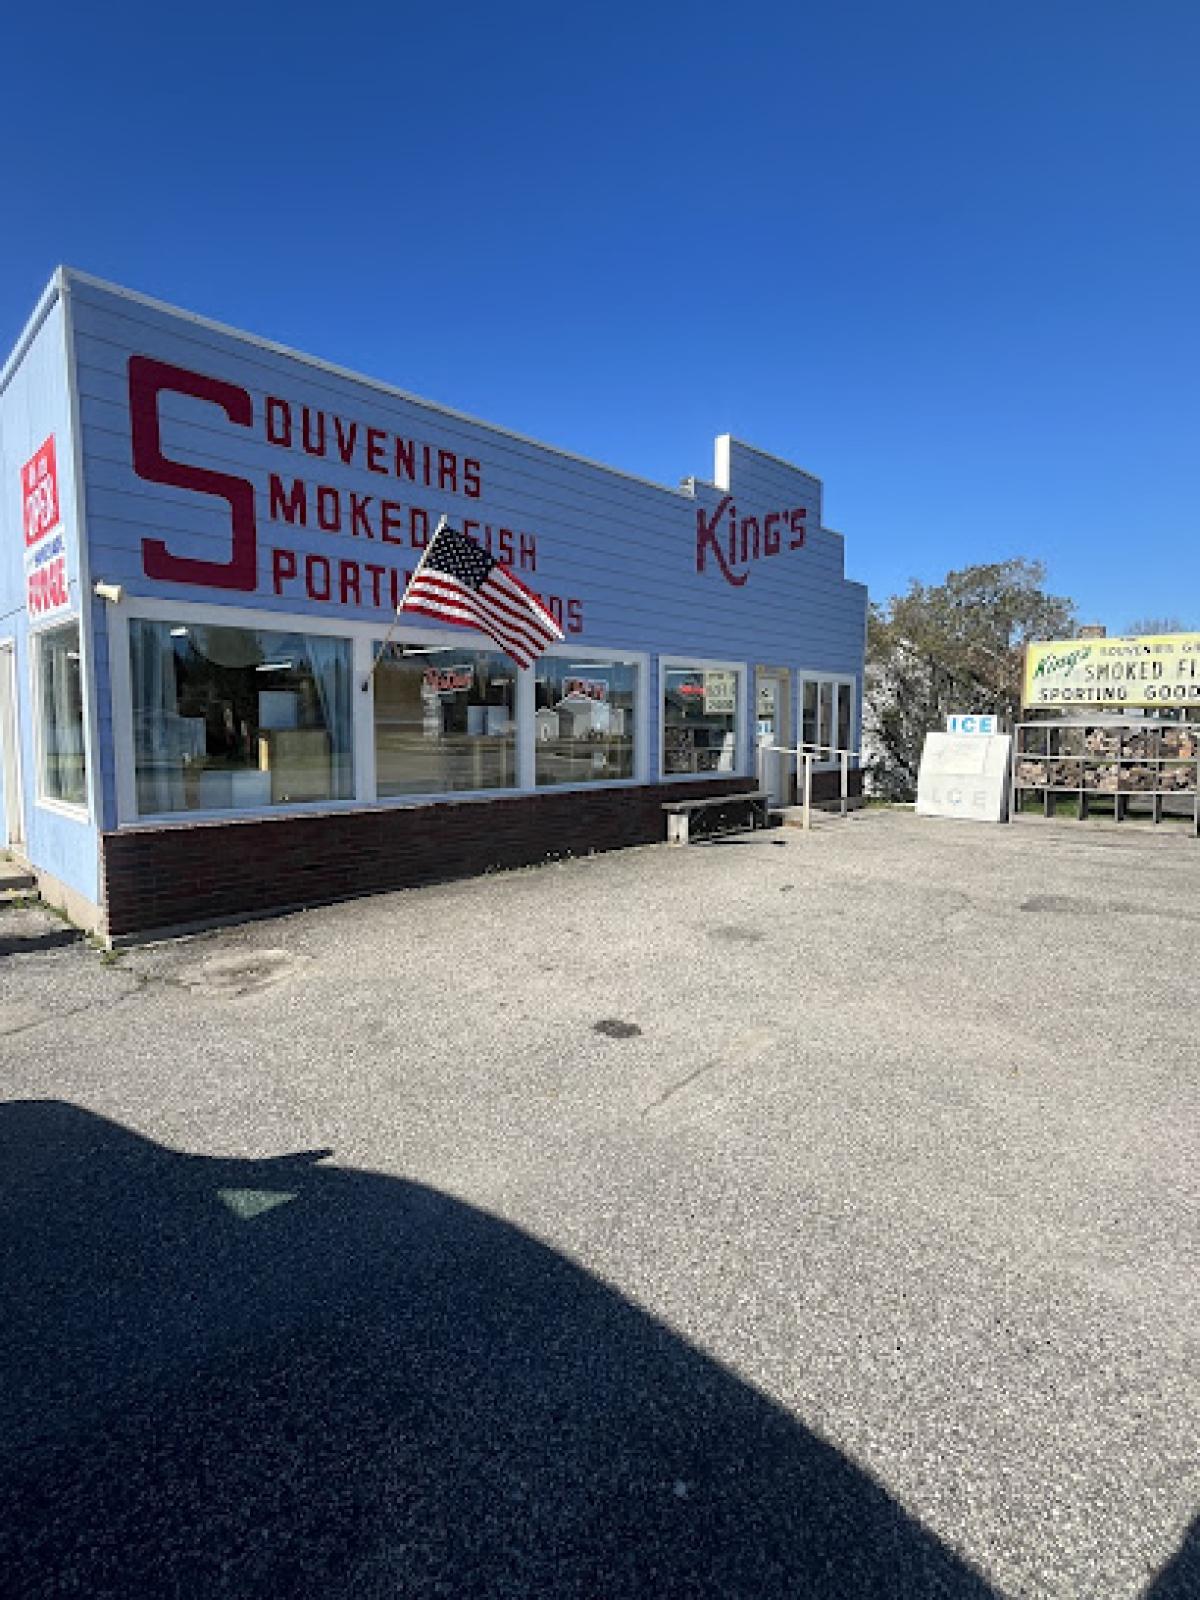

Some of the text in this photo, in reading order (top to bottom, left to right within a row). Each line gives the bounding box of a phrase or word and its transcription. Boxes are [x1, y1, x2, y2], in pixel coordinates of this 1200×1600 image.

[463, 519, 537, 571] FISH
[1084, 658, 1200, 682] SMOKED FI
[1039, 687, 1128, 701] SPORTING
[951, 717, 992, 733] ICE
